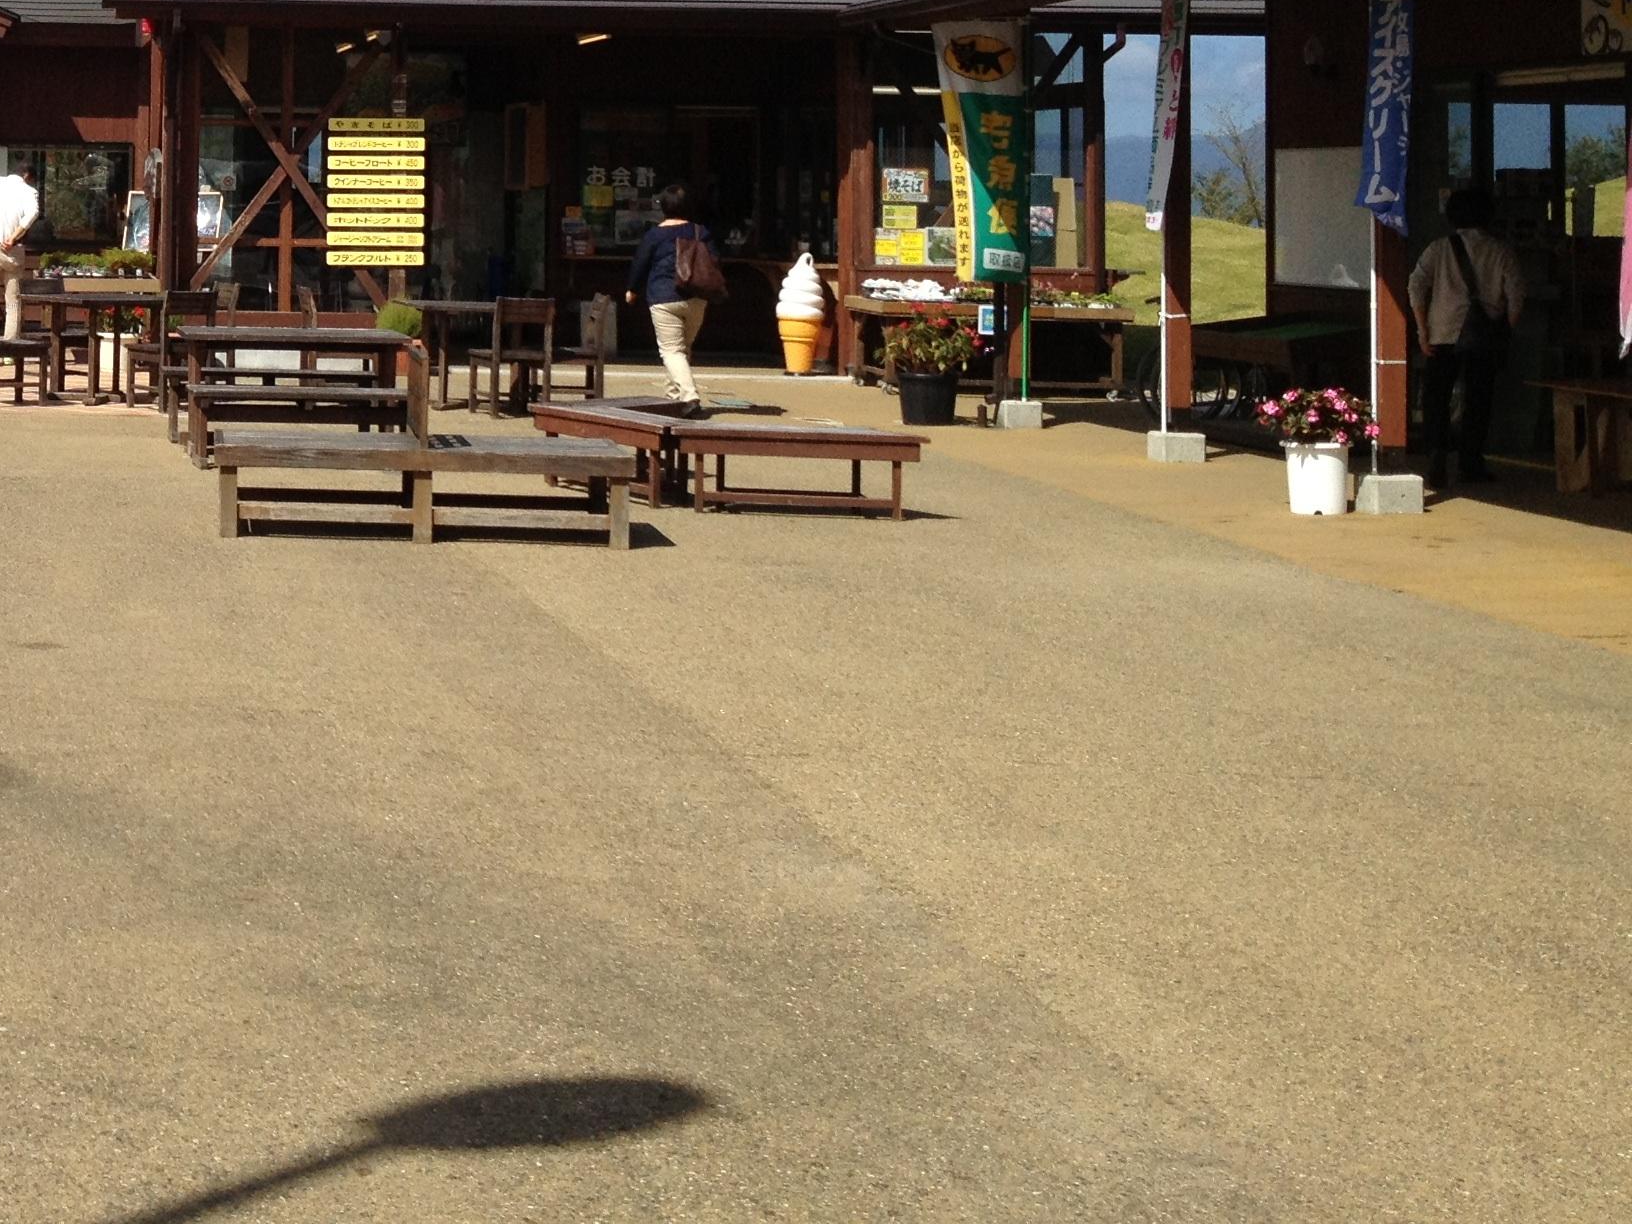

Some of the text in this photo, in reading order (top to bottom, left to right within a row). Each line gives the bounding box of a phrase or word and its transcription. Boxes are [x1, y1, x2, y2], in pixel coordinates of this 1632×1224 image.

[334, 159, 393, 167] コーヒーフロート
[979, 110, 1019, 236] 宅急便
[586, 165, 656, 187] お会計
[888, 178, 923, 193] 焼そば
[949, 123, 970, 266] 当店から荷物が送れます
